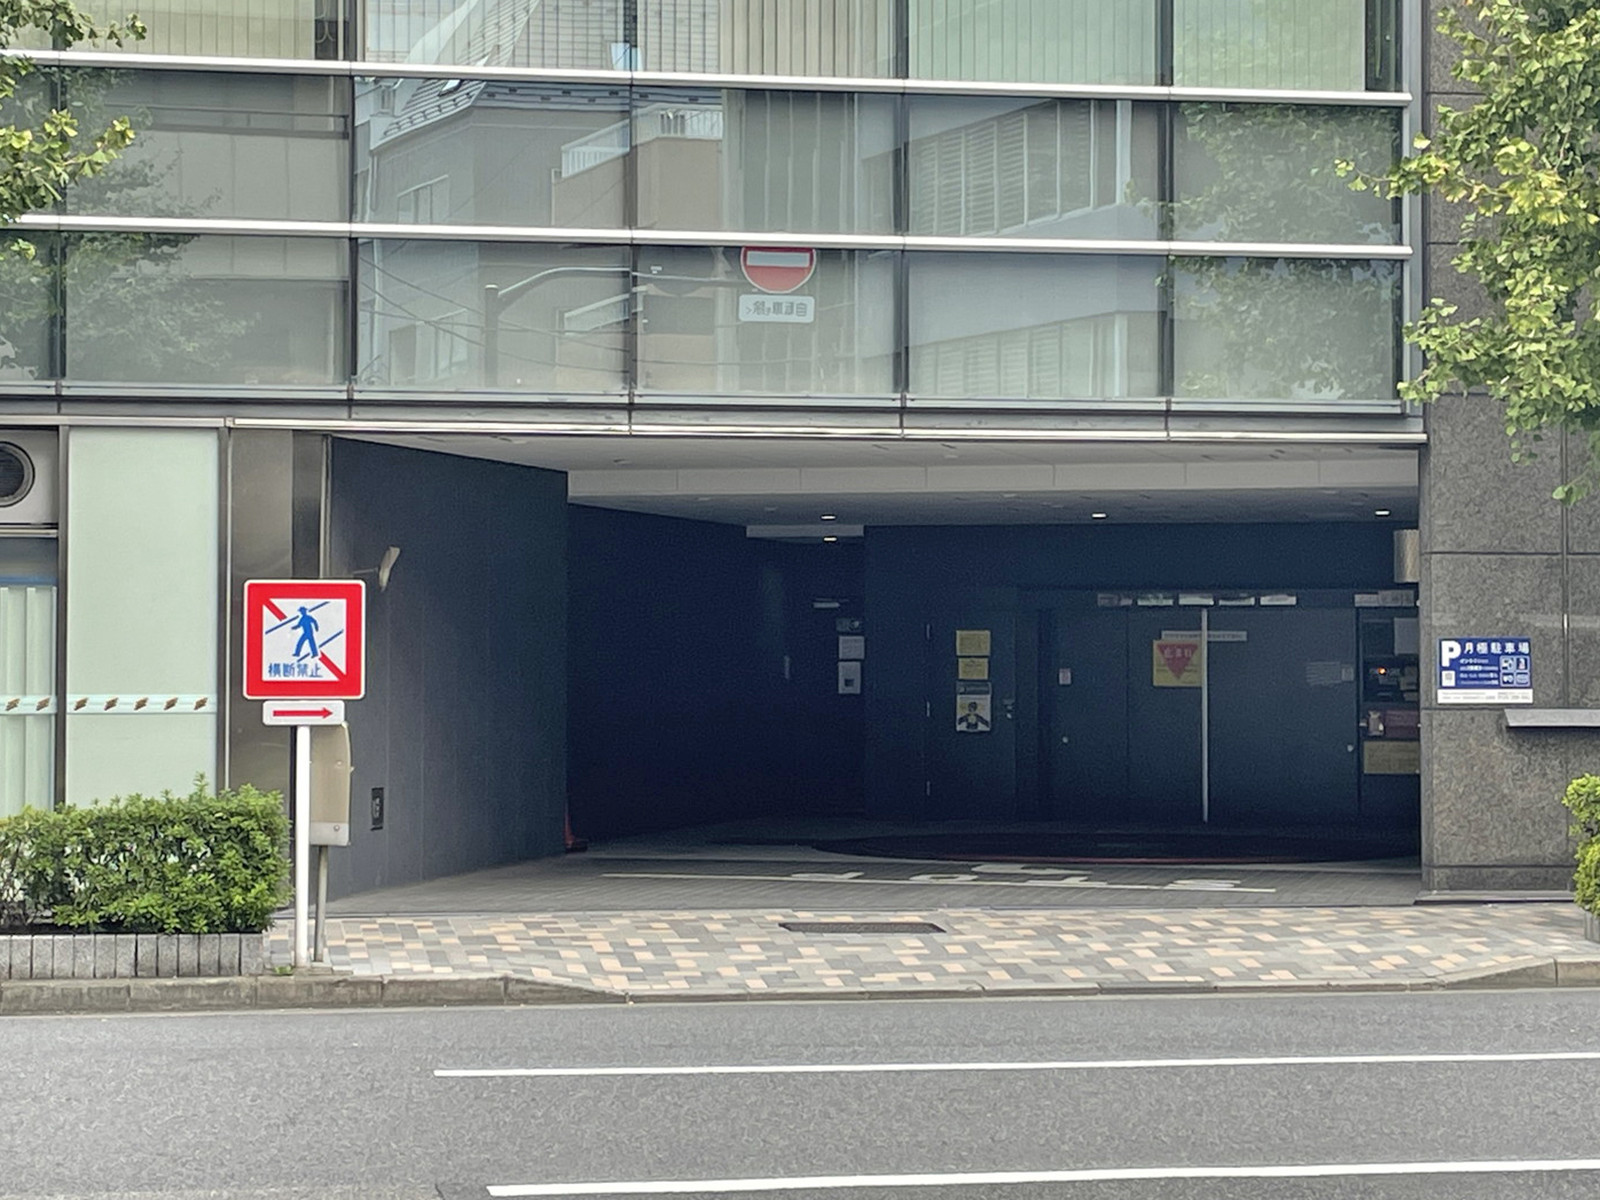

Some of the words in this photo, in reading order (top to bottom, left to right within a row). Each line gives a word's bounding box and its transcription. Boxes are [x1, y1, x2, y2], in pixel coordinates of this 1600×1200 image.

[1441, 640, 1461, 667] P
[268, 662, 323, 678] 横断禁止
